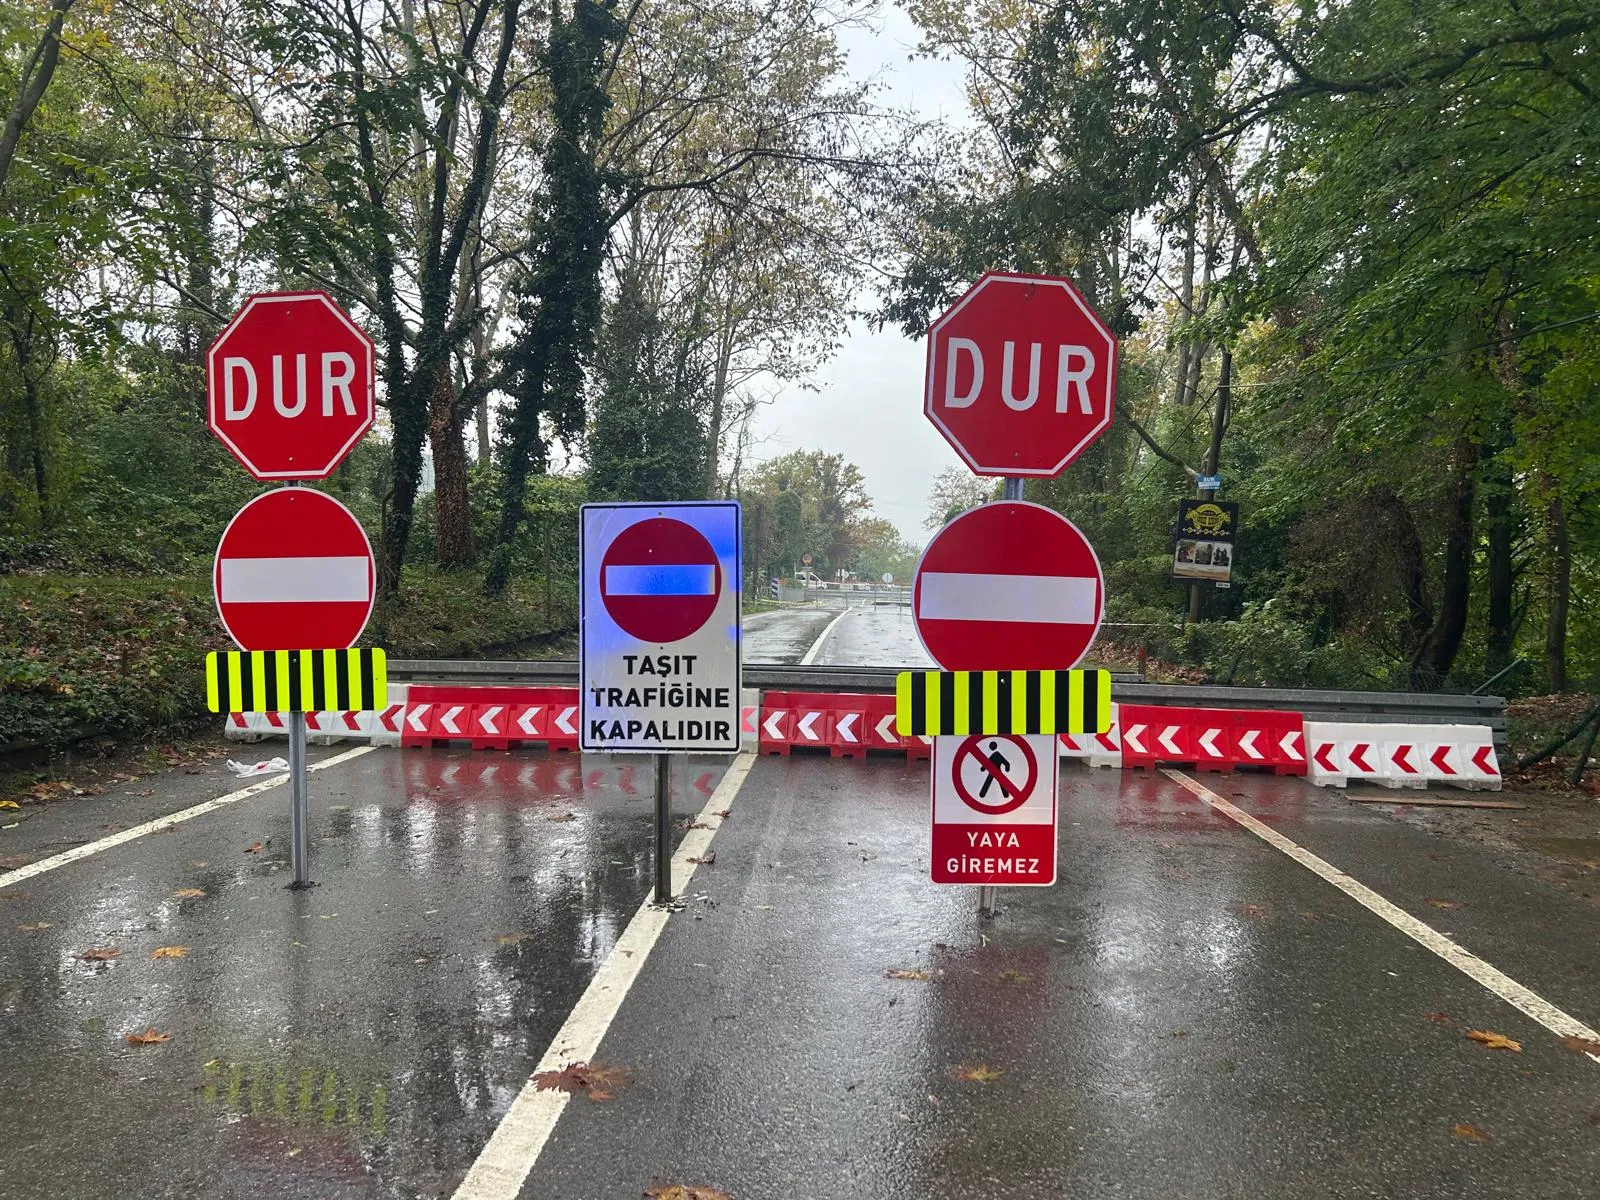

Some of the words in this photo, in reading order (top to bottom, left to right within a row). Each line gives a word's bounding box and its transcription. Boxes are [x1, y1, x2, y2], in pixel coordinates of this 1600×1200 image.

[223, 351, 358, 421] DUR
[944, 337, 1096, 415] DUR
[623, 655, 697, 678] TAŞIT
[591, 682, 730, 708] TRAFİĞİNE
[590, 720, 730, 741] KAPALIDIR
[967, 831, 1020, 848] YAYA
[946, 854, 1039, 874] GİREMEZ
